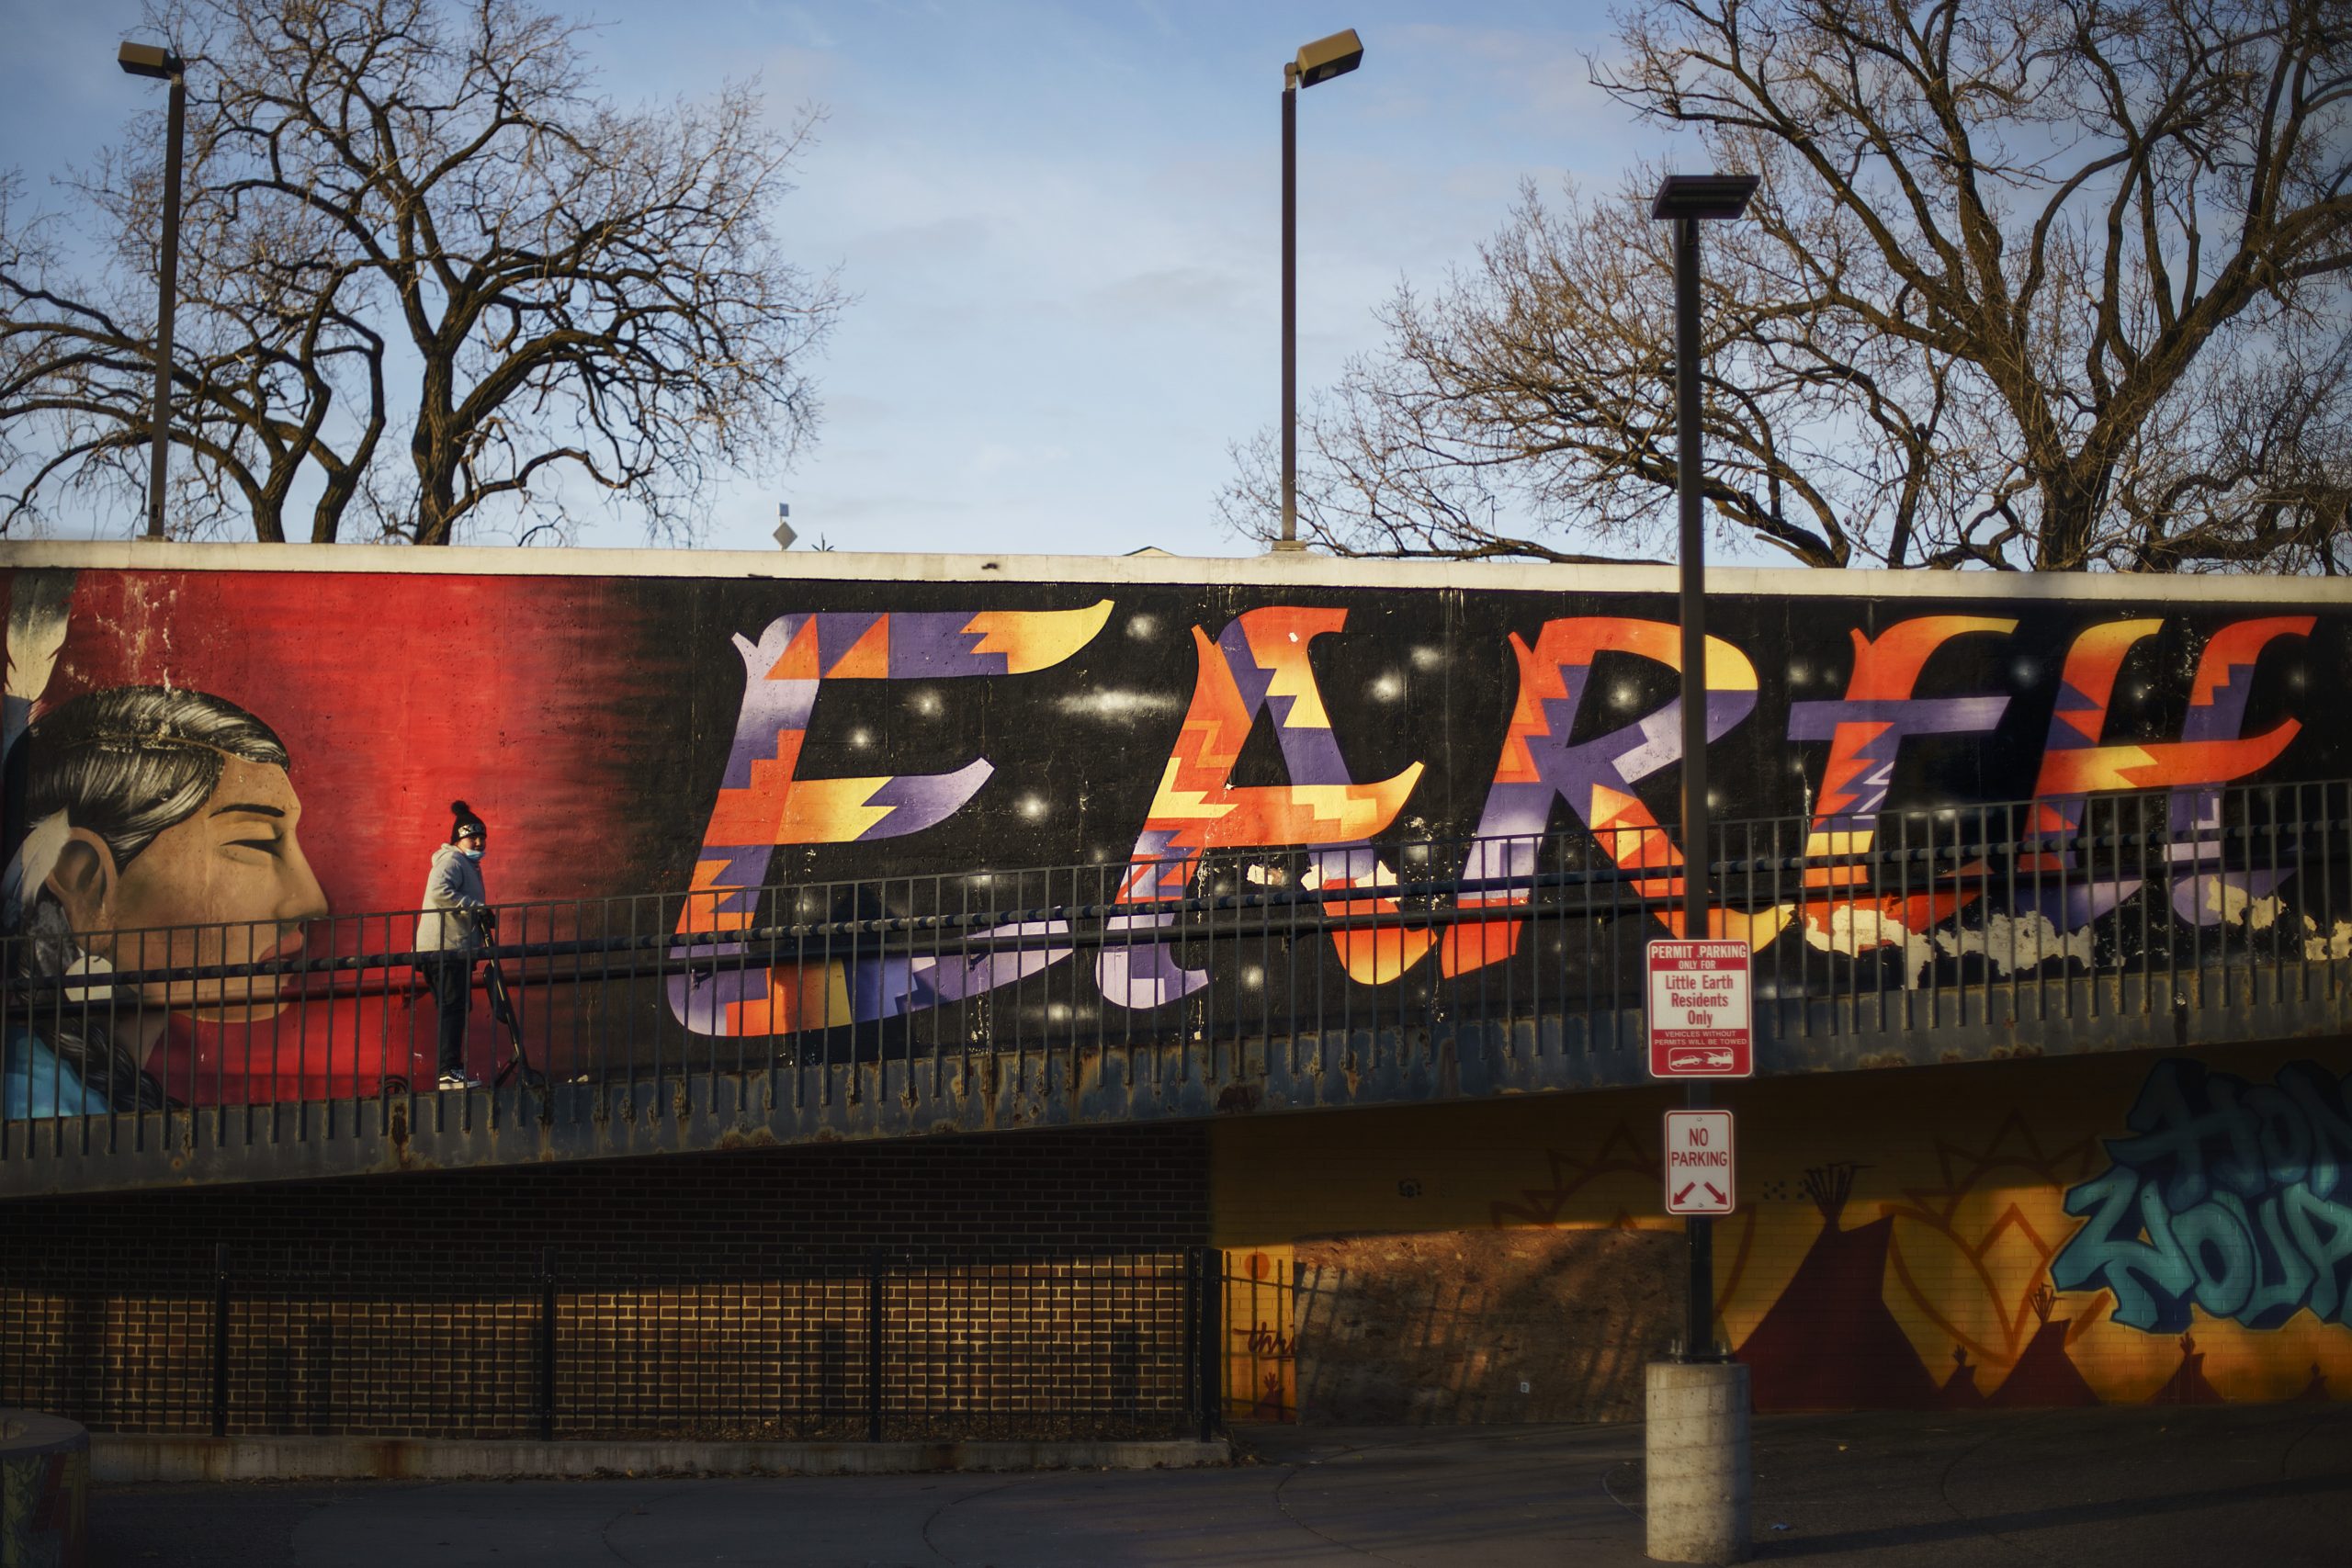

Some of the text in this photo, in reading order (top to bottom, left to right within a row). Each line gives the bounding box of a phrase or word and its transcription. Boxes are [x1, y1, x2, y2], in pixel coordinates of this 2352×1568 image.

[1651, 945, 1747, 959] PERMIT PARKING
[1679, 960, 1716, 970] ONLY FOR
[1666, 975, 1734, 990] Little Earth
[1671, 992, 1729, 1008] Residents
[1688, 1010, 1713, 1028] Only
[1689, 1127, 1709, 1147] NO
[1671, 1151, 1728, 1168] PARKING
